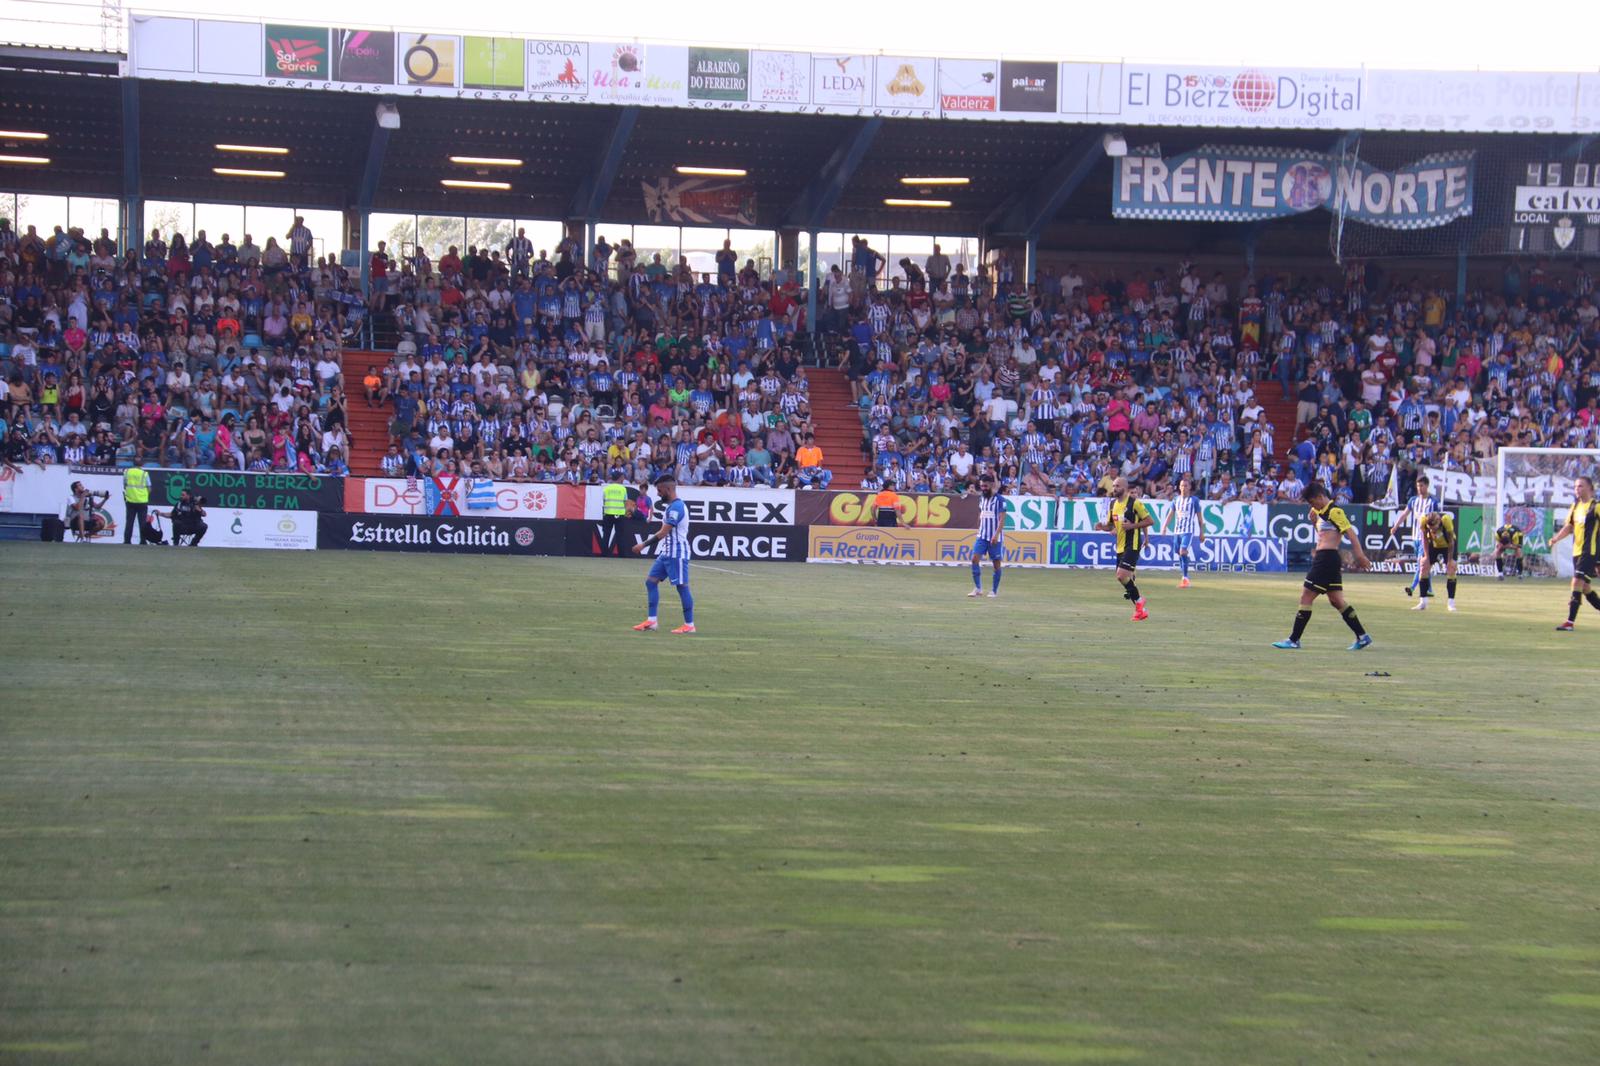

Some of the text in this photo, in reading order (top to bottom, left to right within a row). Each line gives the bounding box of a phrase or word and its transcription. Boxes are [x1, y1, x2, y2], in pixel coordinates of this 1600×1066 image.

[276, 49, 299, 63] Sgt.
[529, 42, 582, 56] LOSADA
[690, 77, 746, 91] DO FERREIRO
[822, 75, 865, 91] LEDA
[1012, 76, 1046, 88] paixar
[1183, 75, 1199, 87] 15
[267, 80, 382, 92] GRACIAS
[413, 87, 423, 96] A
[457, 90, 589, 102] VOSOTROS
[687, 101, 768, 111] SOMOS
[856, 108, 946, 117] EQUIP
[942, 95, 989, 109] Valderiz
[1127, 73, 1150, 106] El
[1277, 76, 1362, 117] Digital
[1148, 115, 1157, 123] EL
[1158, 115, 1192, 124] DECANO
[1193, 116, 1203, 124] DE
[1205, 116, 1215, 124] LA
[1217, 116, 1246, 125] PRENSA
[1247, 117, 1277, 125] DIGITAL
[1279, 118, 1291, 126] DEL
[1485, 115, 1555, 129] 409
[1121, 157, 1467, 214] FRENTE NORTE
[1514, 212, 1550, 223] LOCAL
[195, 473, 321, 490] ONDA BIERZO
[1425, 467, 1575, 504] FRENTE
[217, 493, 300, 509] 101.6 FM
[653, 500, 789, 523] SEREX
[350, 521, 510, 547] Estrella Galicia
[855, 532, 880, 542] Grupo
[835, 541, 899, 559] Recalvi
[1199, 538, 1285, 564] SIMON
